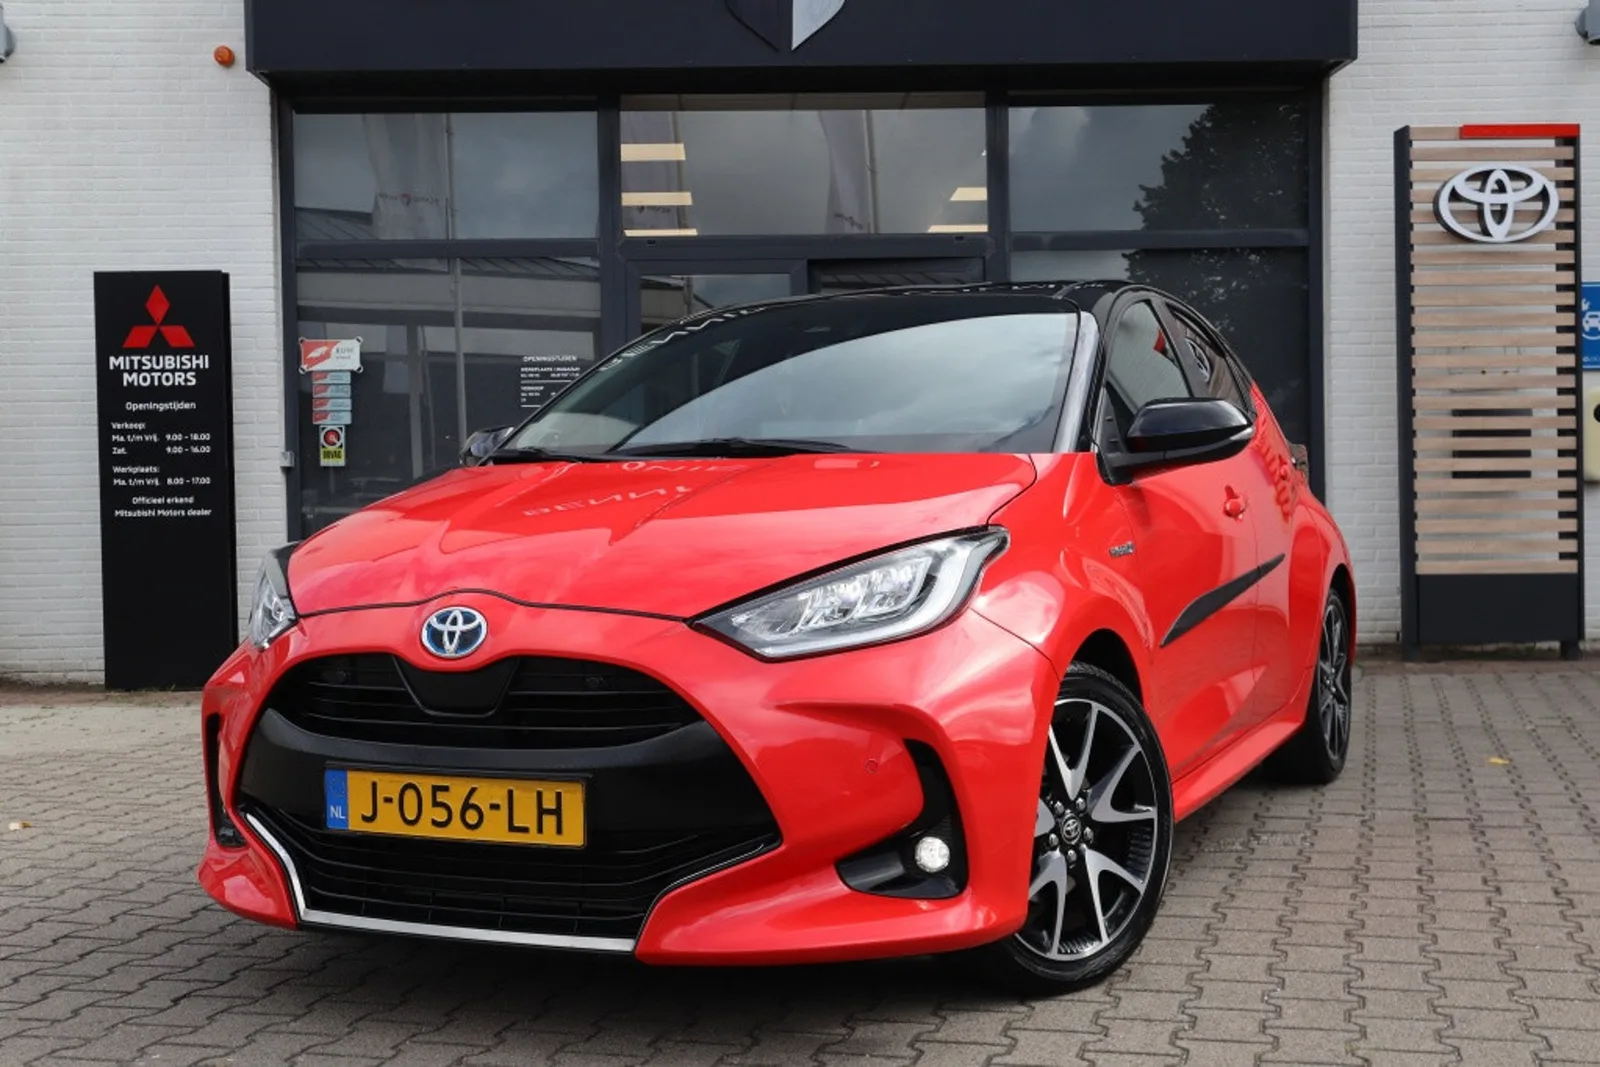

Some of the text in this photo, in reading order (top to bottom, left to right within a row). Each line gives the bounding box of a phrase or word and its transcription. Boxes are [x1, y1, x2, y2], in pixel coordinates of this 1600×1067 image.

[109, 355, 209, 370] MITSUBISHI
[123, 372, 196, 387] MOTORS
[125, 401, 196, 412] Openingstijden
[127, 434, 142, 442] t/m
[165, 433, 183, 441] 9.00
[190, 433, 211, 441] 18.00
[165, 445, 184, 454] 9.00
[190, 445, 211, 453] 16.00
[128, 478, 144, 486] t/m
[166, 477, 184, 485] 8.00
[191, 477, 211, 485] 17.00
[132, 496, 195, 504] Officieel erkend
[115, 509, 156, 517] Mitsubishi
[187, 508, 212, 517] dealer
[329, 780, 564, 836] NL J-056-LH
